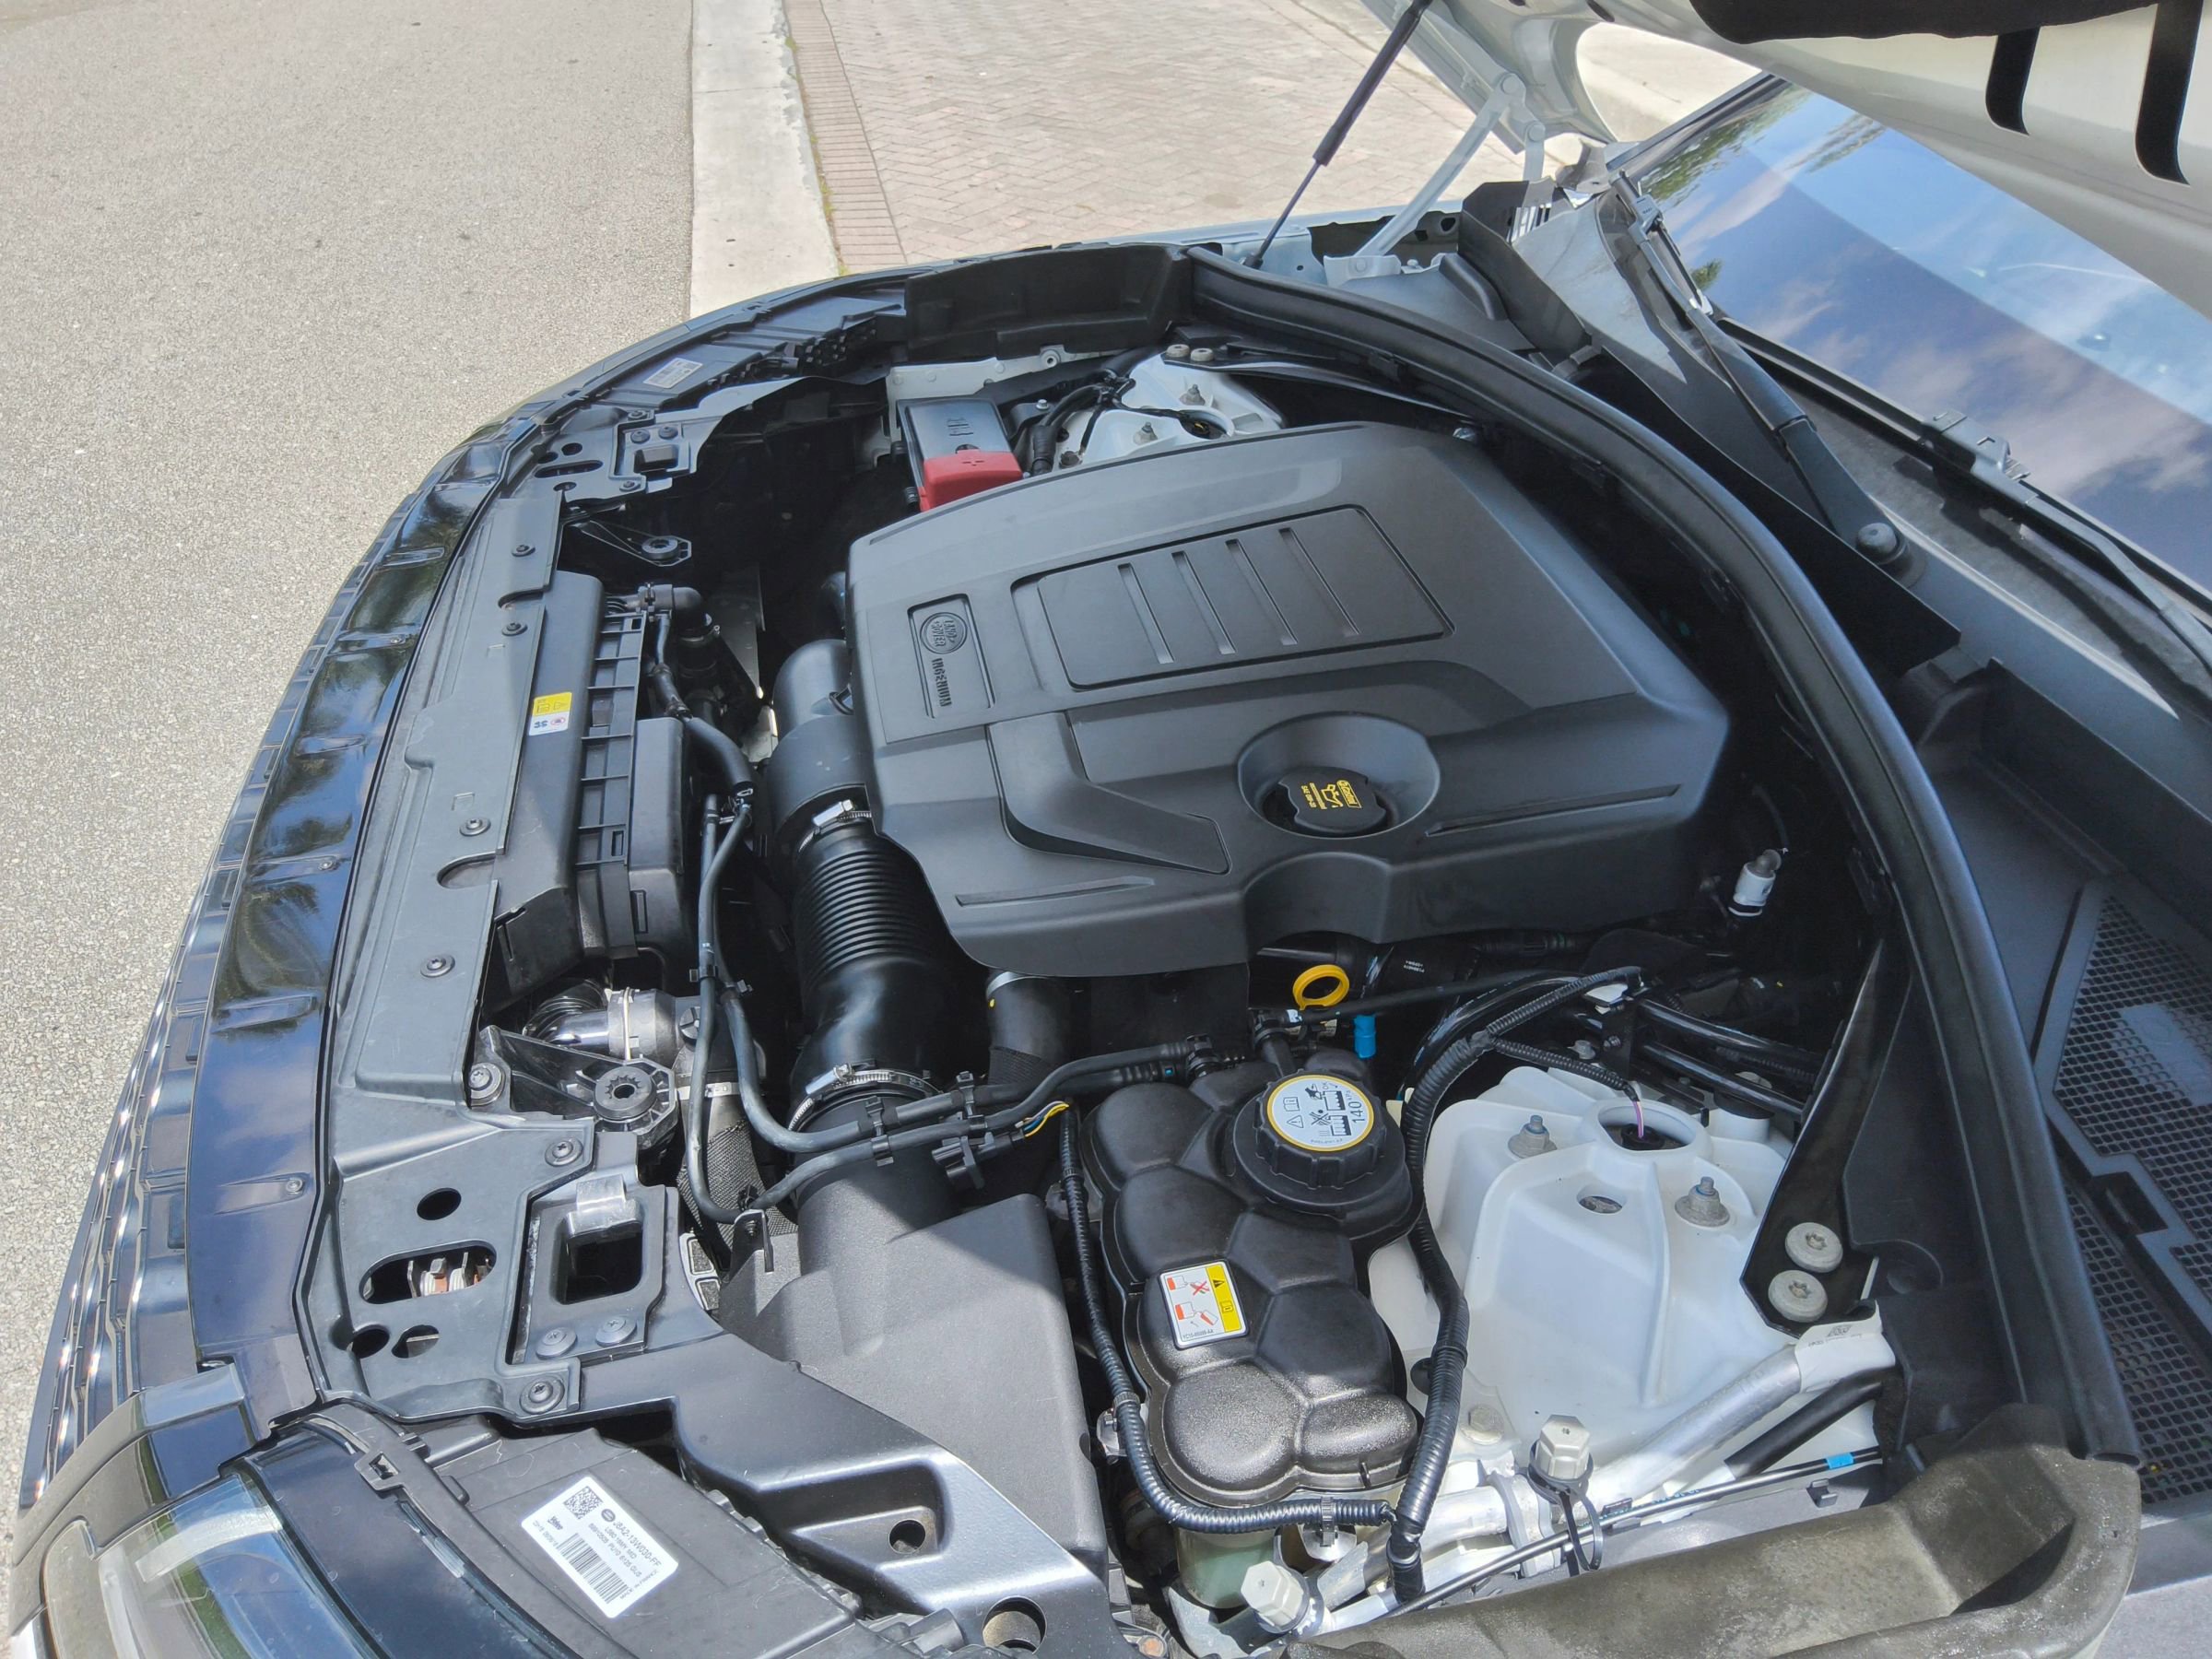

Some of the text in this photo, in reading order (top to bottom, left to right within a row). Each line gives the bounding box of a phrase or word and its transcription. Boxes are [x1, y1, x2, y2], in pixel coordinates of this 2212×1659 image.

[932, 624, 947, 647] ROVER
[931, 657, 952, 707] INGENIUM
[1347, 1100, 1365, 1124] 140
